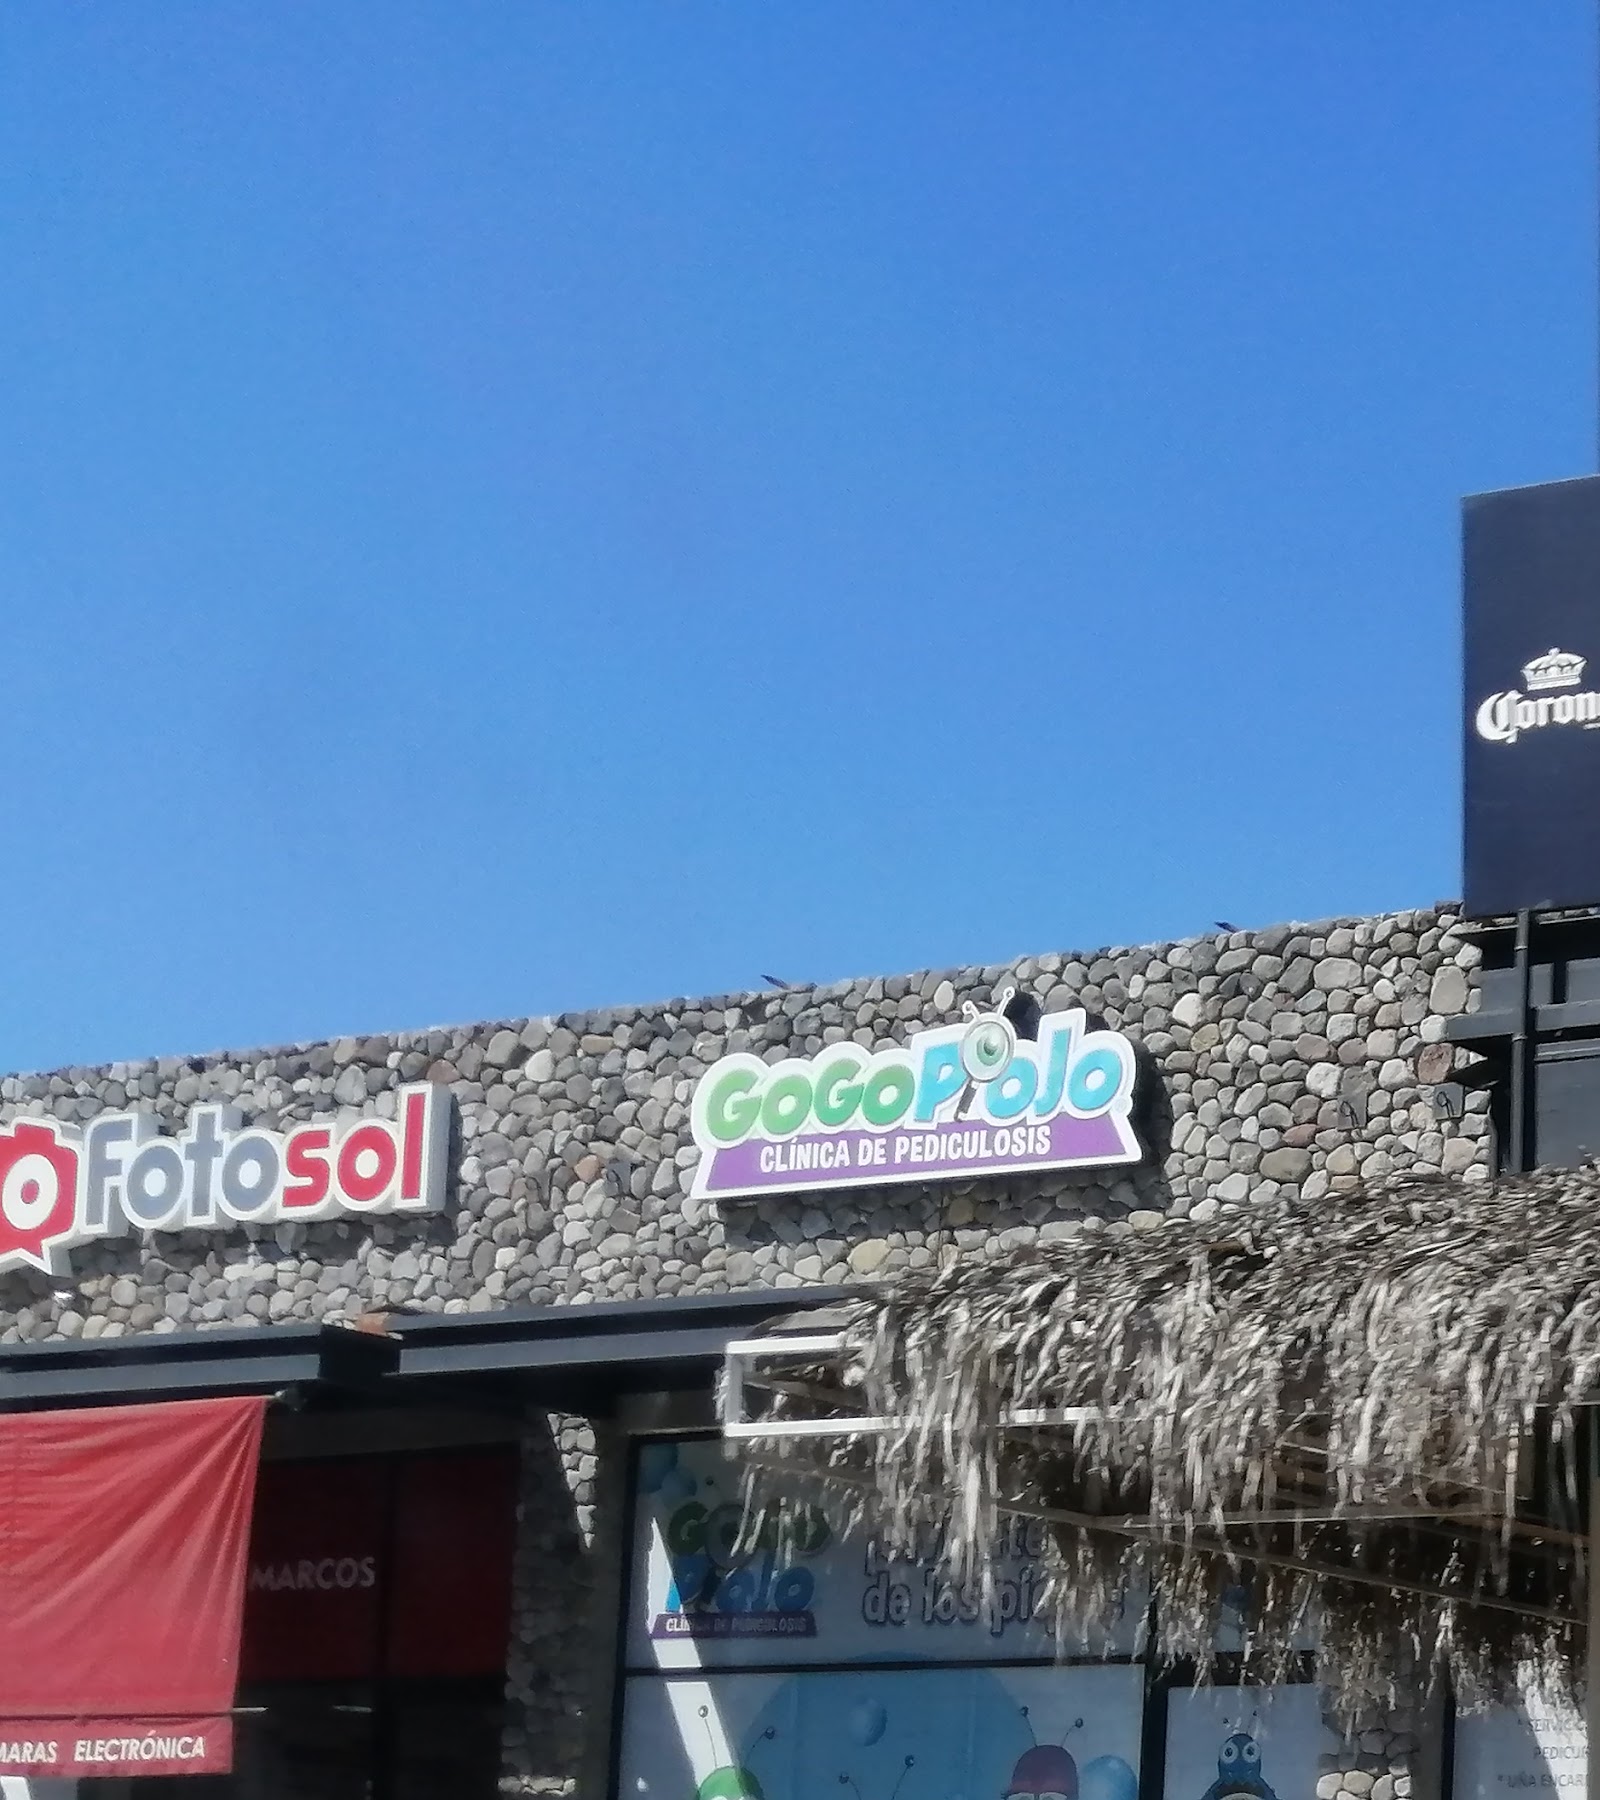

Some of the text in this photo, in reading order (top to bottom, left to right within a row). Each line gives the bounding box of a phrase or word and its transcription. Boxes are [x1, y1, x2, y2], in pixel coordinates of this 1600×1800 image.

[759, 1125, 1051, 1174] CLÍNICA DE PEDICULOSIS
[249, 1556, 376, 1592] MARCOS
[74, 1729, 207, 1763] ELECTRÓNICA
[1540, 1773, 1587, 1787] ENCAR
